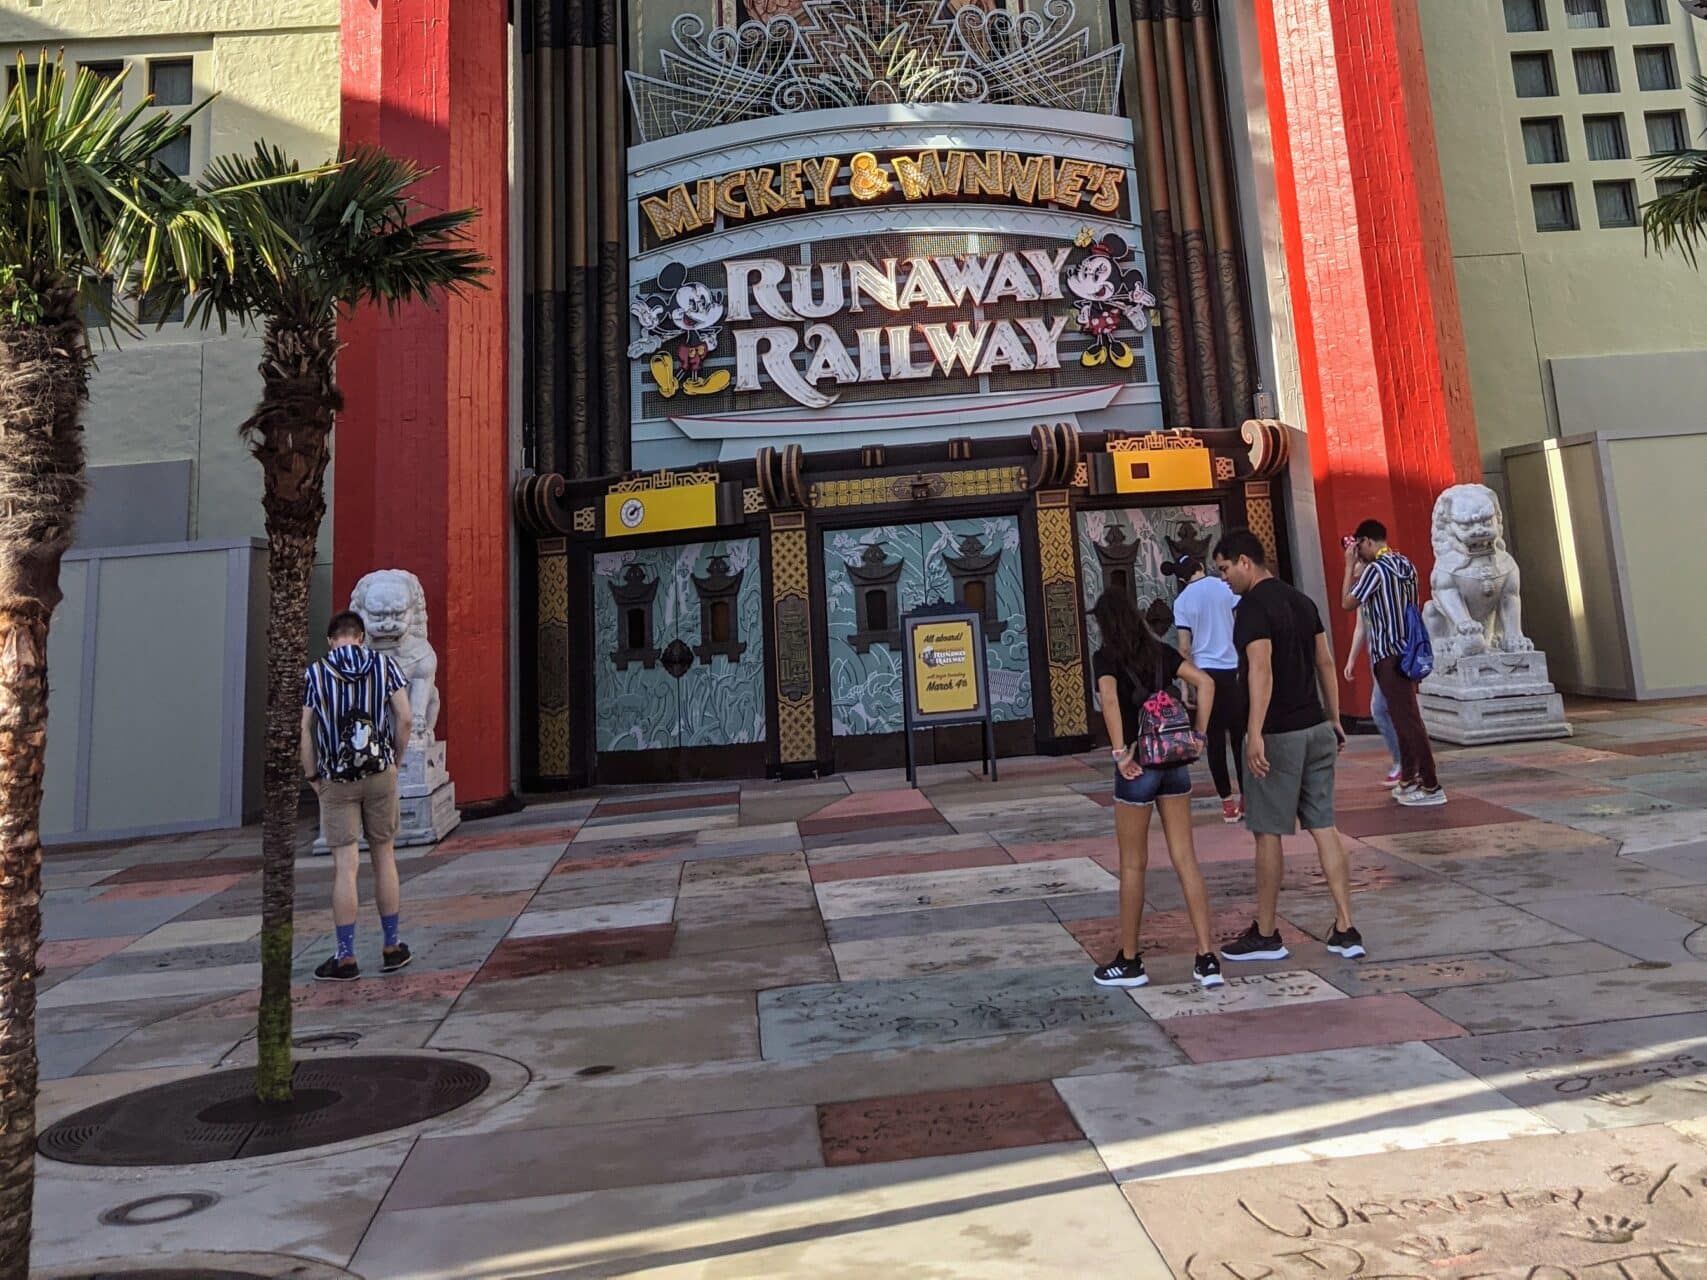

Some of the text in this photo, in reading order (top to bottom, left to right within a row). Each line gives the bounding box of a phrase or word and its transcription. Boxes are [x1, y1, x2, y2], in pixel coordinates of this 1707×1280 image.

[640, 149, 1126, 240] MICKEY & MINNIE'S
[722, 247, 1073, 322] RUNAWAY
[733, 316, 1070, 408] RAILWAY
